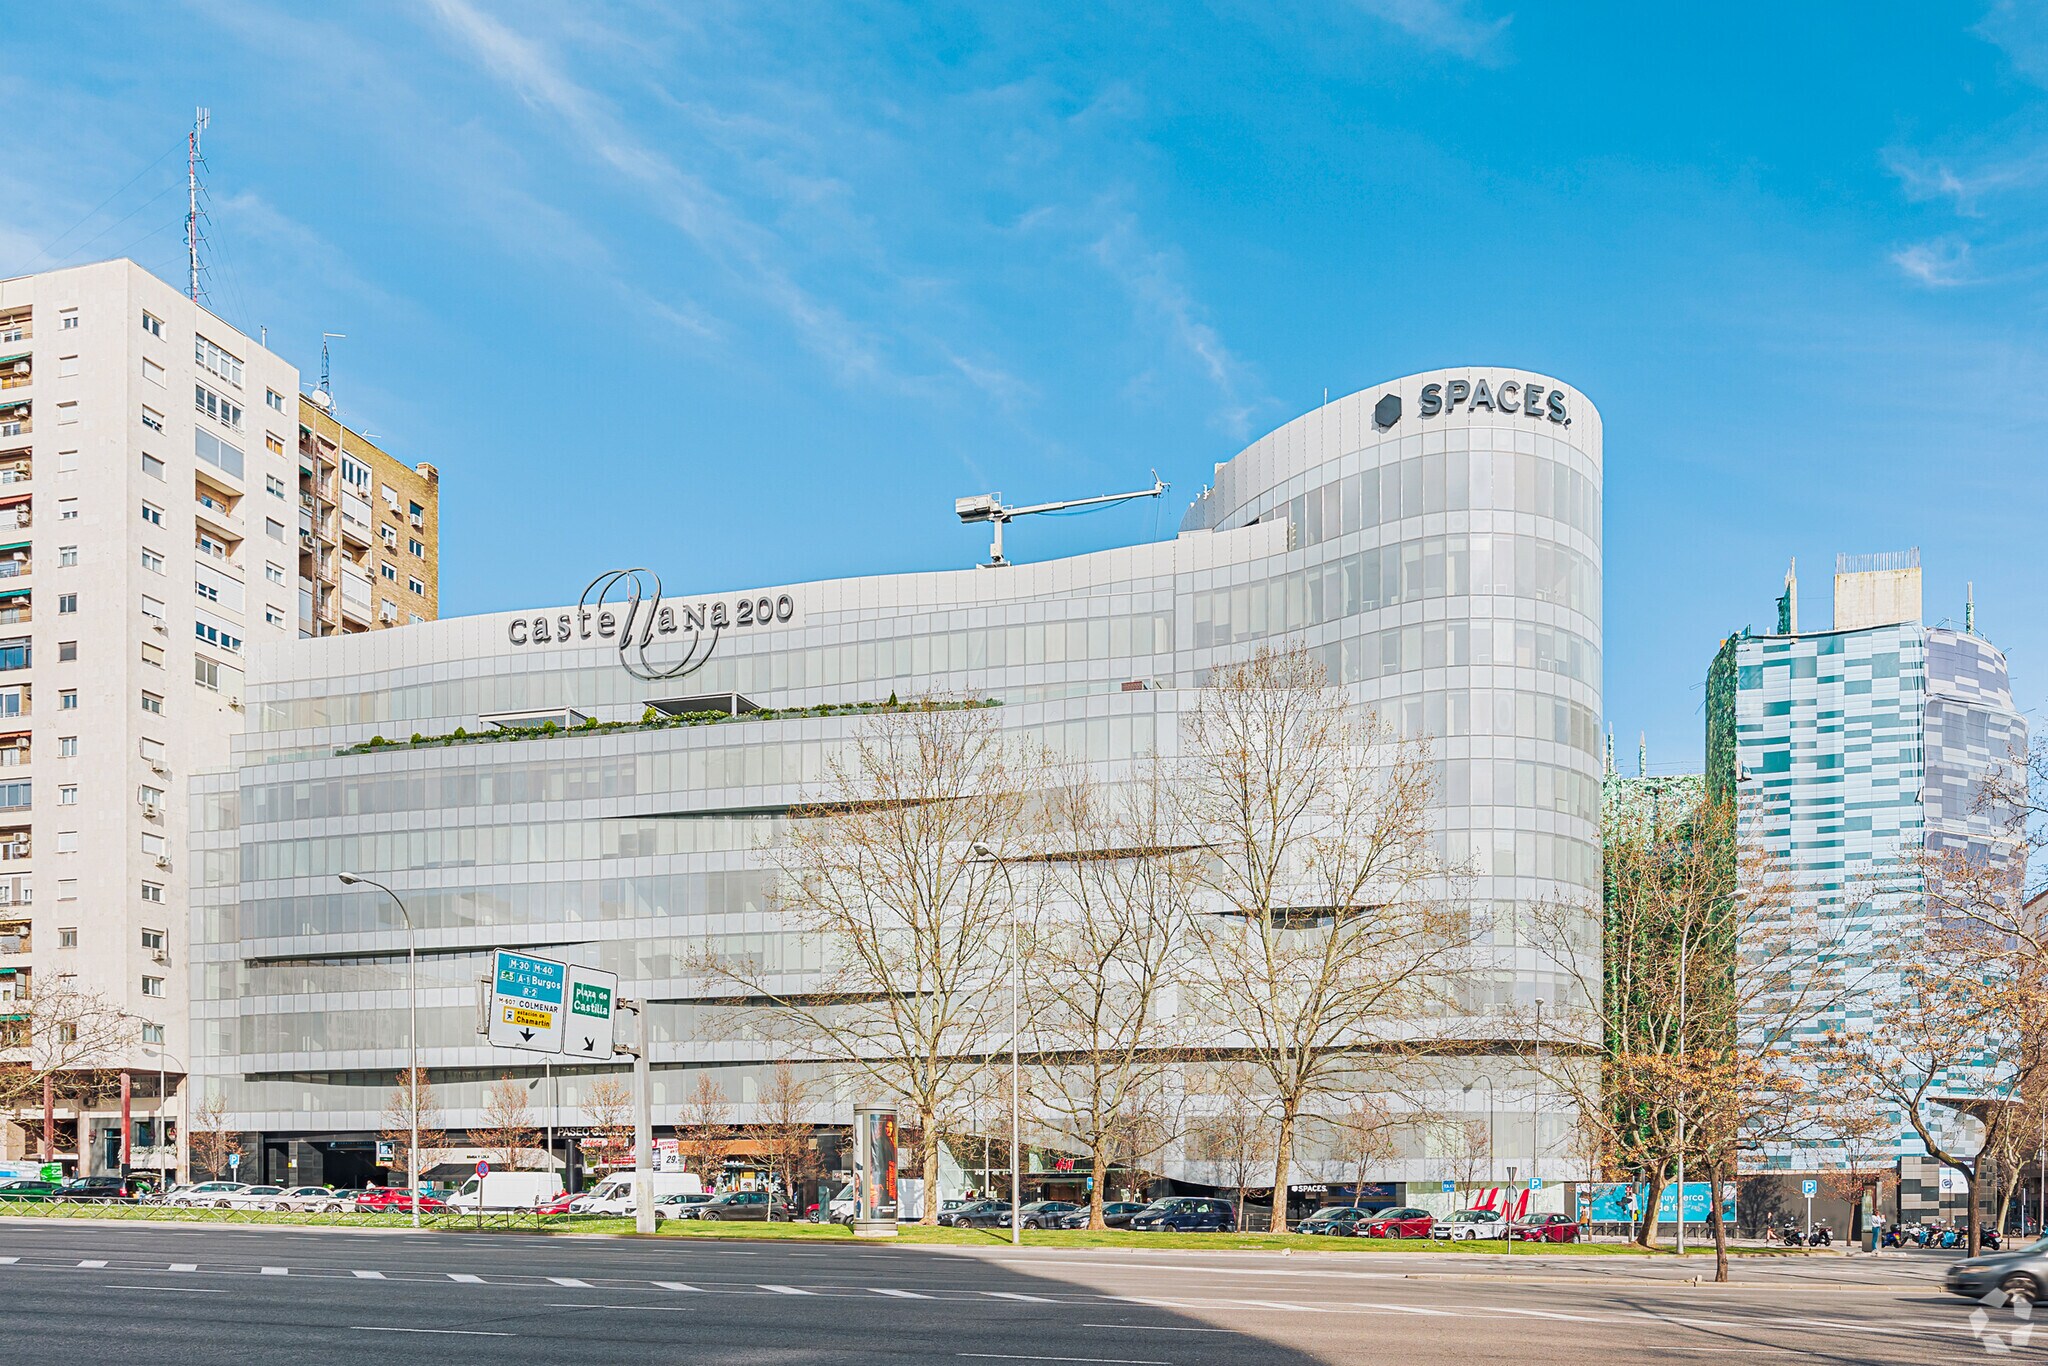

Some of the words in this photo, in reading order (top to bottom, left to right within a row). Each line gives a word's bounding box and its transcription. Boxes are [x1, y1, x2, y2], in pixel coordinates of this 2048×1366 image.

[510, 959, 530, 971] M-30
[534, 963, 554, 975] M-40
[532, 975, 561, 990] Burgos
[523, 987, 537, 997] R-2
[576, 983, 597, 998] plaza
[598, 991, 608, 1000] de
[519, 1000, 559, 1014] COLMENAR
[573, 1000, 608, 1015] Castilla
[557, 1127, 590, 1137] PASEO
[1683, 1194, 1704, 1202] erca
